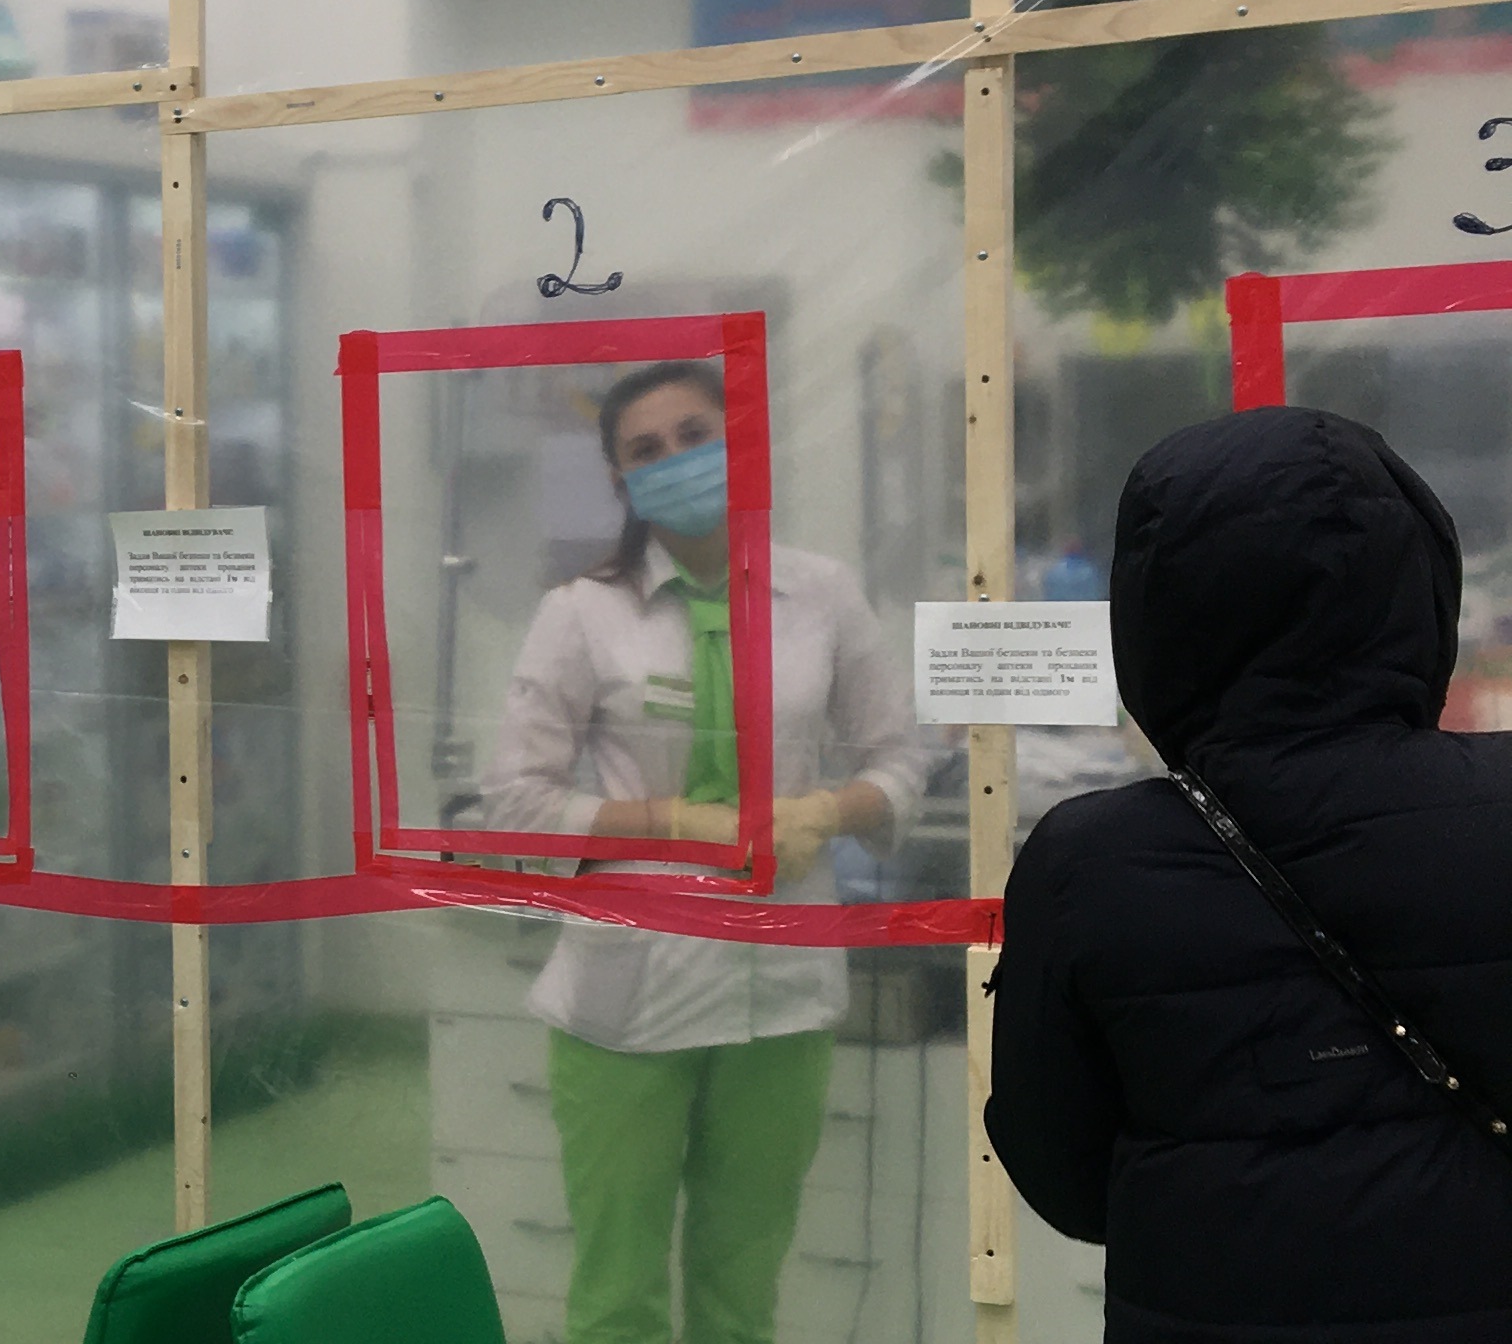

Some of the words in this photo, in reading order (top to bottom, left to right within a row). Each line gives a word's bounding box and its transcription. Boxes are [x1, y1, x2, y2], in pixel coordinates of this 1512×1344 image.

[534, 197, 624, 298] 2
[928, 648, 958, 658] Задля
[961, 648, 994, 658] Вашої
[996, 648, 1038, 658] безпеки
[1041, 650, 1053, 658] та
[1055, 647, 1098, 658] безпеки
[928, 662, 983, 672] персоналу
